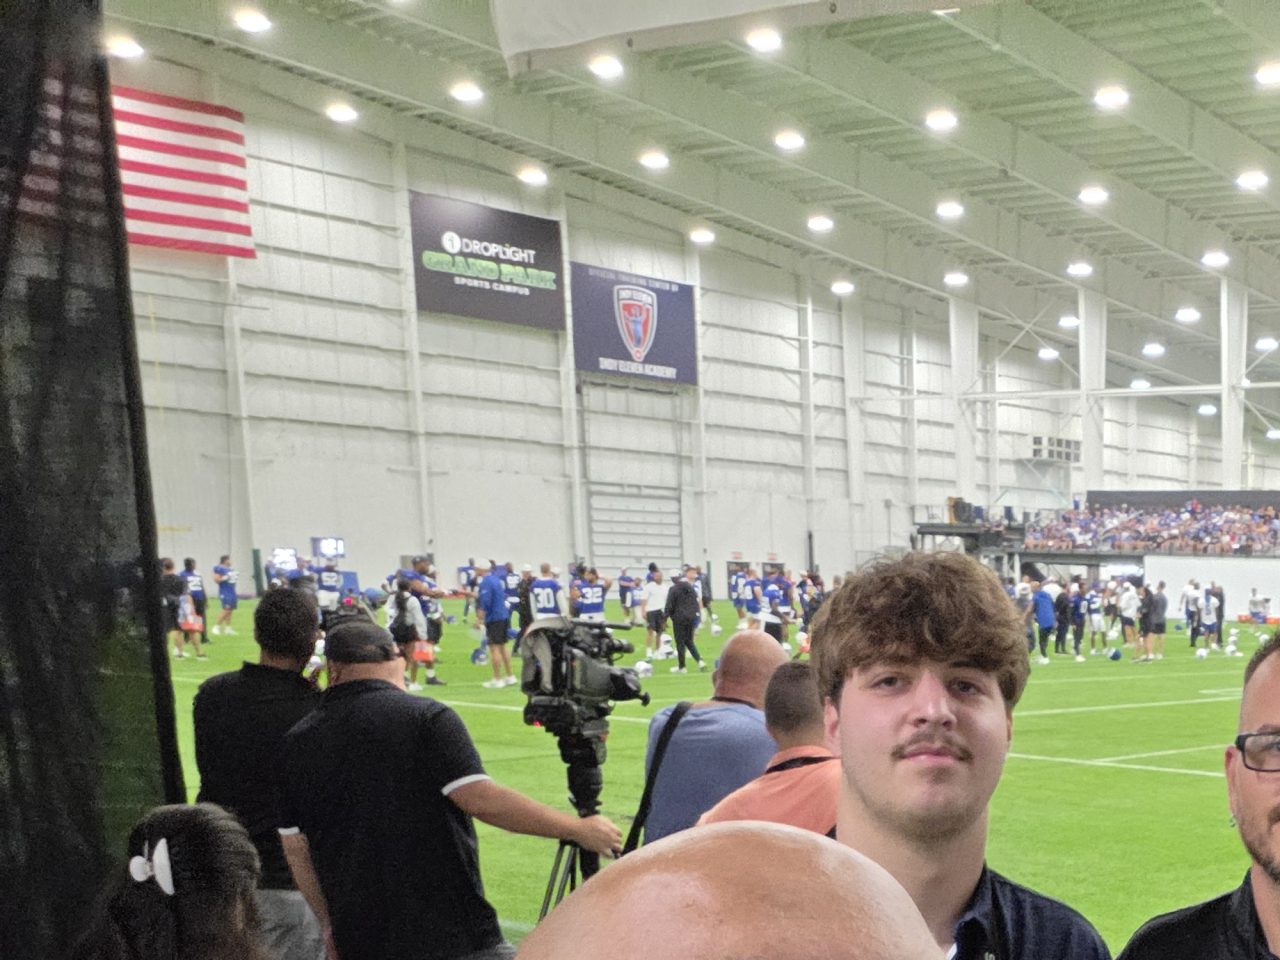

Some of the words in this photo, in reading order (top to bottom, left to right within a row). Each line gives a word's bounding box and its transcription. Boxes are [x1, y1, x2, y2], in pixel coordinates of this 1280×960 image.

[461, 238, 536, 263] DROPLIGHT
[454, 276, 490, 289] SPORTS
[492, 283, 530, 295] CAMPUS
[533, 588, 555, 608] 30
